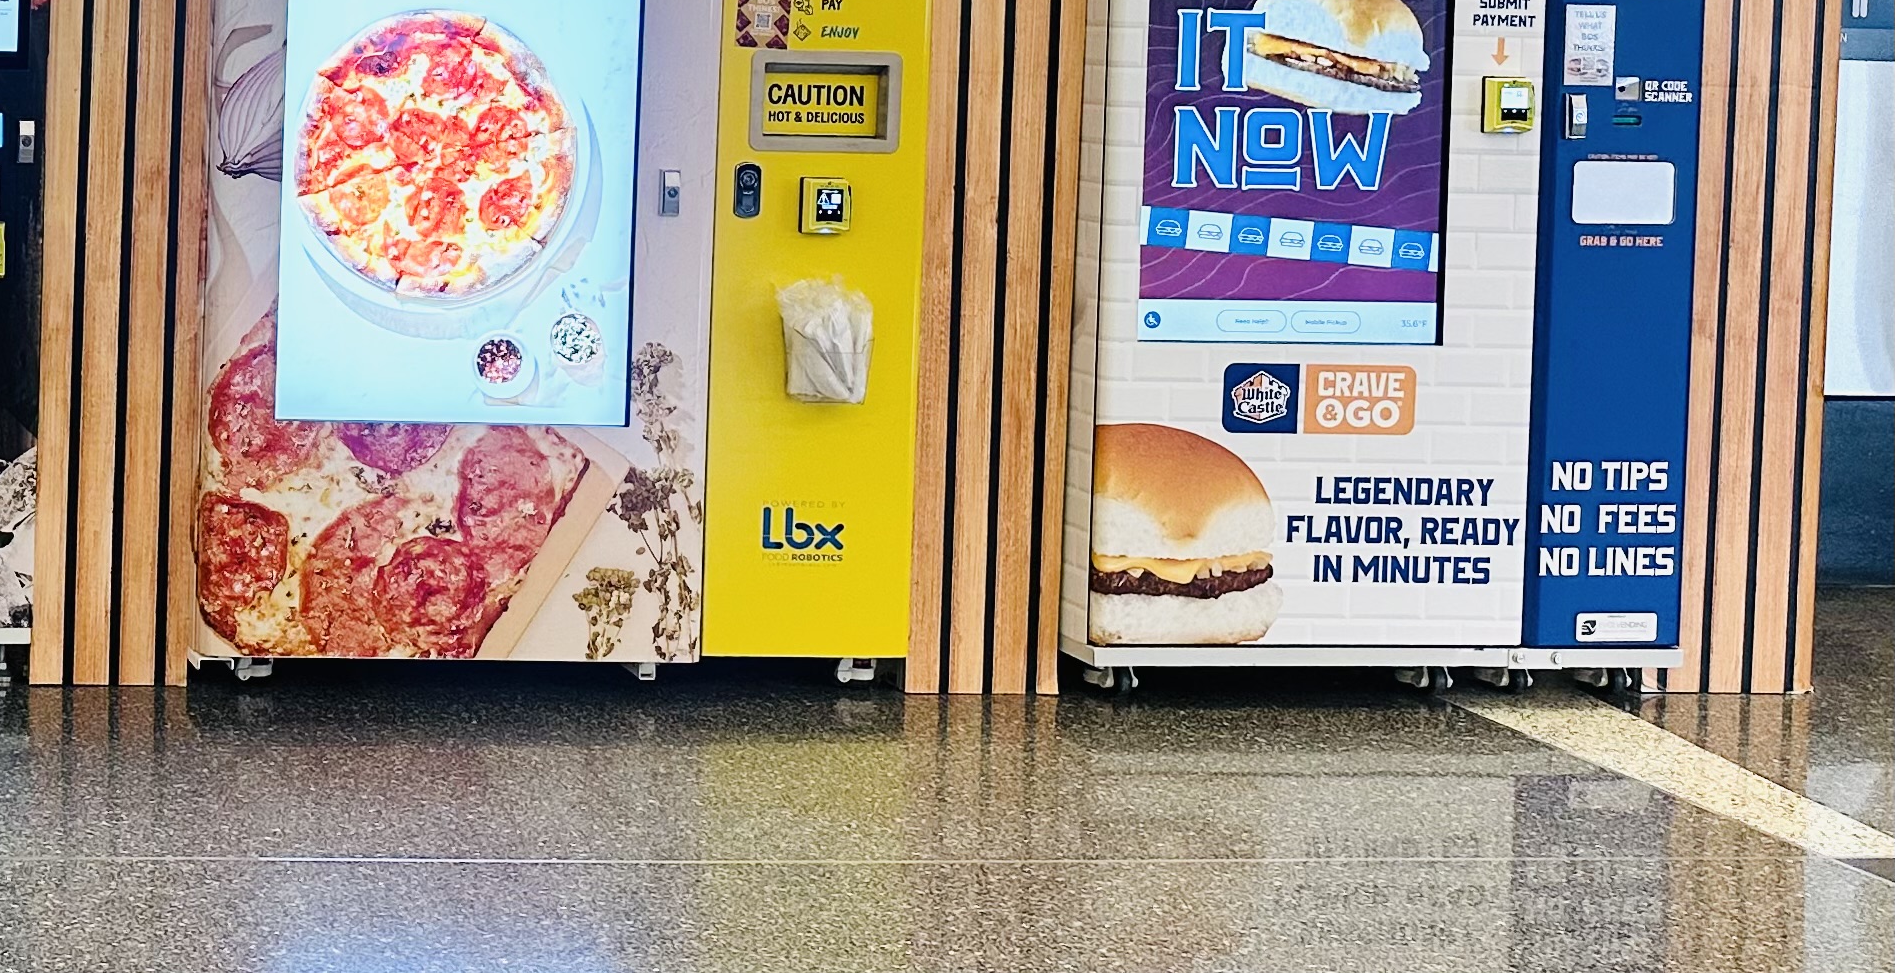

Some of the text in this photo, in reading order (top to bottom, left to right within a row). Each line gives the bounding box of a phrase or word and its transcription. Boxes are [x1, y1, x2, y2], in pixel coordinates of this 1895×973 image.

[821, 0, 843, 10] PAY
[821, 26, 860, 39] ENJOY
[1473, 14, 1536, 27] PAYMENT
[1175, 8, 1266, 92] IT
[767, 83, 865, 108] CAUTION
[1644, 92, 1692, 102] SCANNER
[1645, 81, 1687, 91] QR CODE
[768, 111, 865, 124] HOT & DELICIOUS
[1171, 105, 1393, 191] NOW
[1580, 236, 1663, 246] GRAB & GO HERE
[1242, 388, 1281, 402] White
[1318, 372, 1405, 397] CRAVE
[1238, 401, 1283, 413] Castle
[1552, 461, 1668, 491] NO TIPS
[1315, 476, 1494, 506] LEGENDARY
[762, 507, 845, 550] Lbx
[1286, 516, 1519, 548] FLAVOR, READY
[1540, 505, 1676, 534] NO FEES
[762, 553, 789, 561] FOOD
[1539, 547, 1674, 577] NO LINES
[1313, 555, 1490, 585] IN MINUTES
